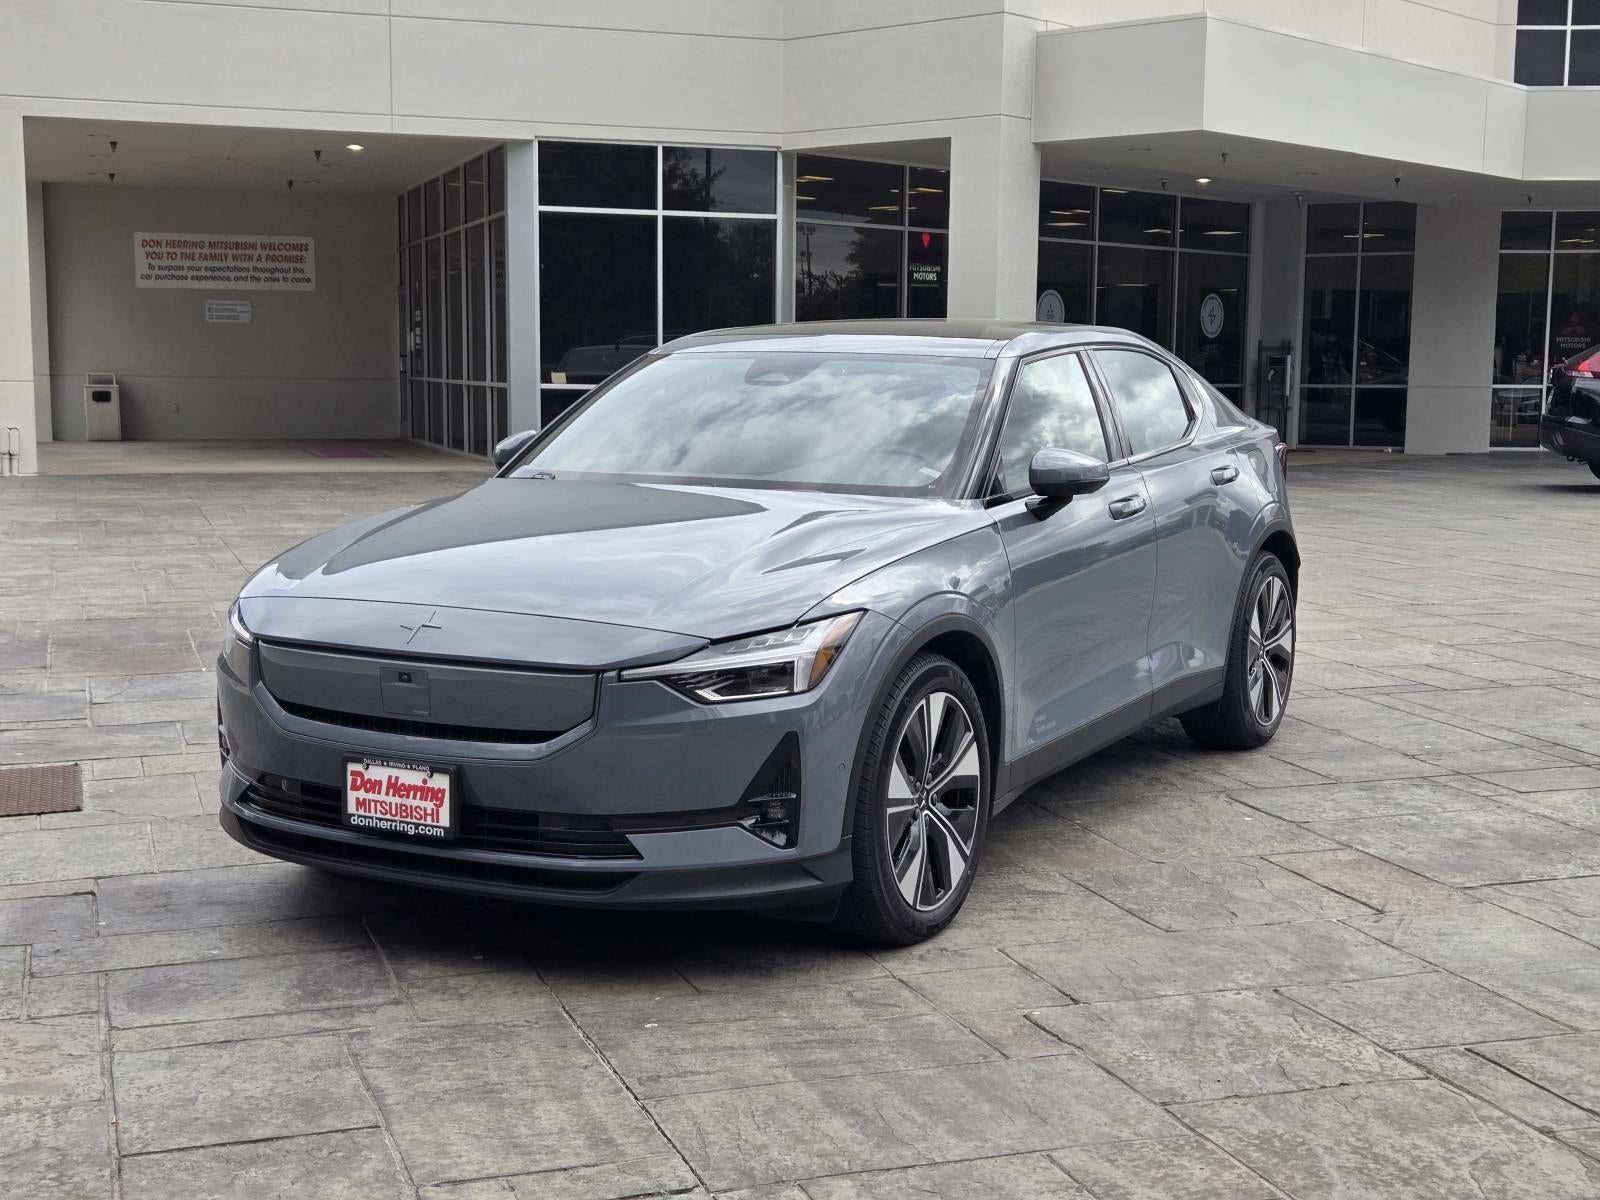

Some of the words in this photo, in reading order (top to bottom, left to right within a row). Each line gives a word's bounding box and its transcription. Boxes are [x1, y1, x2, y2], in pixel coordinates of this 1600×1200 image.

[141, 239, 162, 248] DON
[165, 239, 205, 250] HERRING
[208, 241, 258, 251] MITSUBISHI
[260, 242, 310, 252] WELCOMES
[145, 251, 164, 261] YOU
[166, 251, 178, 261] TO
[180, 252, 196, 261] THE
[198, 252, 229, 262] FAMILY
[231, 253, 253, 263] WITH
[256, 254, 262, 262] A
[265, 254, 307, 264] PROMISE:
[157, 265, 185, 274] surpass
[204, 265, 251, 274] expectations
[252, 265, 292, 275] throughout
[293, 266, 305, 274] this
[914, 272, 937, 280] MOTORS
[154, 274, 188, 282] purchase
[250, 275, 261, 283] the
[350, 769, 383, 795] Don
[385, 775, 446, 808] Herring
[355, 797, 440, 823] MITSUBISHI
[350, 815, 444, 836] donherring.com
